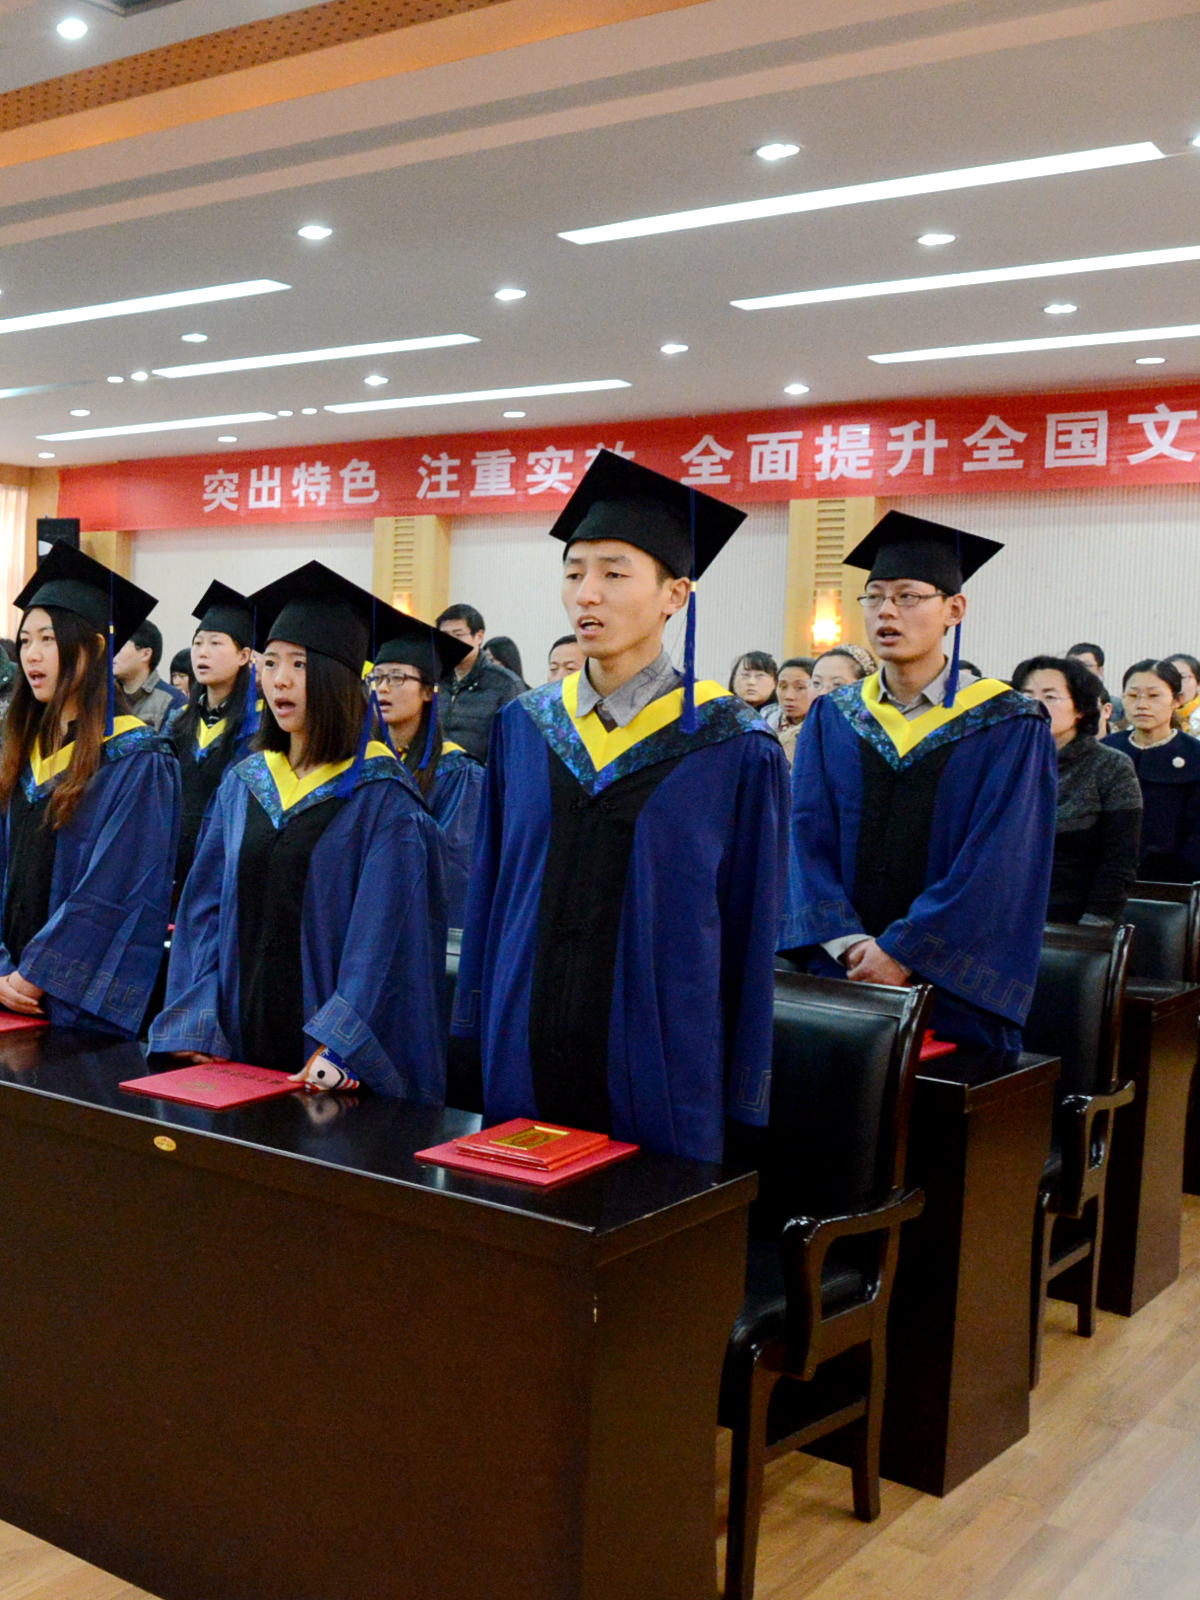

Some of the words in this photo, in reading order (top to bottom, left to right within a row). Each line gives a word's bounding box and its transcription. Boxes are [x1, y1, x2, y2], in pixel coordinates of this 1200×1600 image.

[203, 458, 379, 513] 突出特色
[680, 403, 1198, 485] 全面提升全国文
